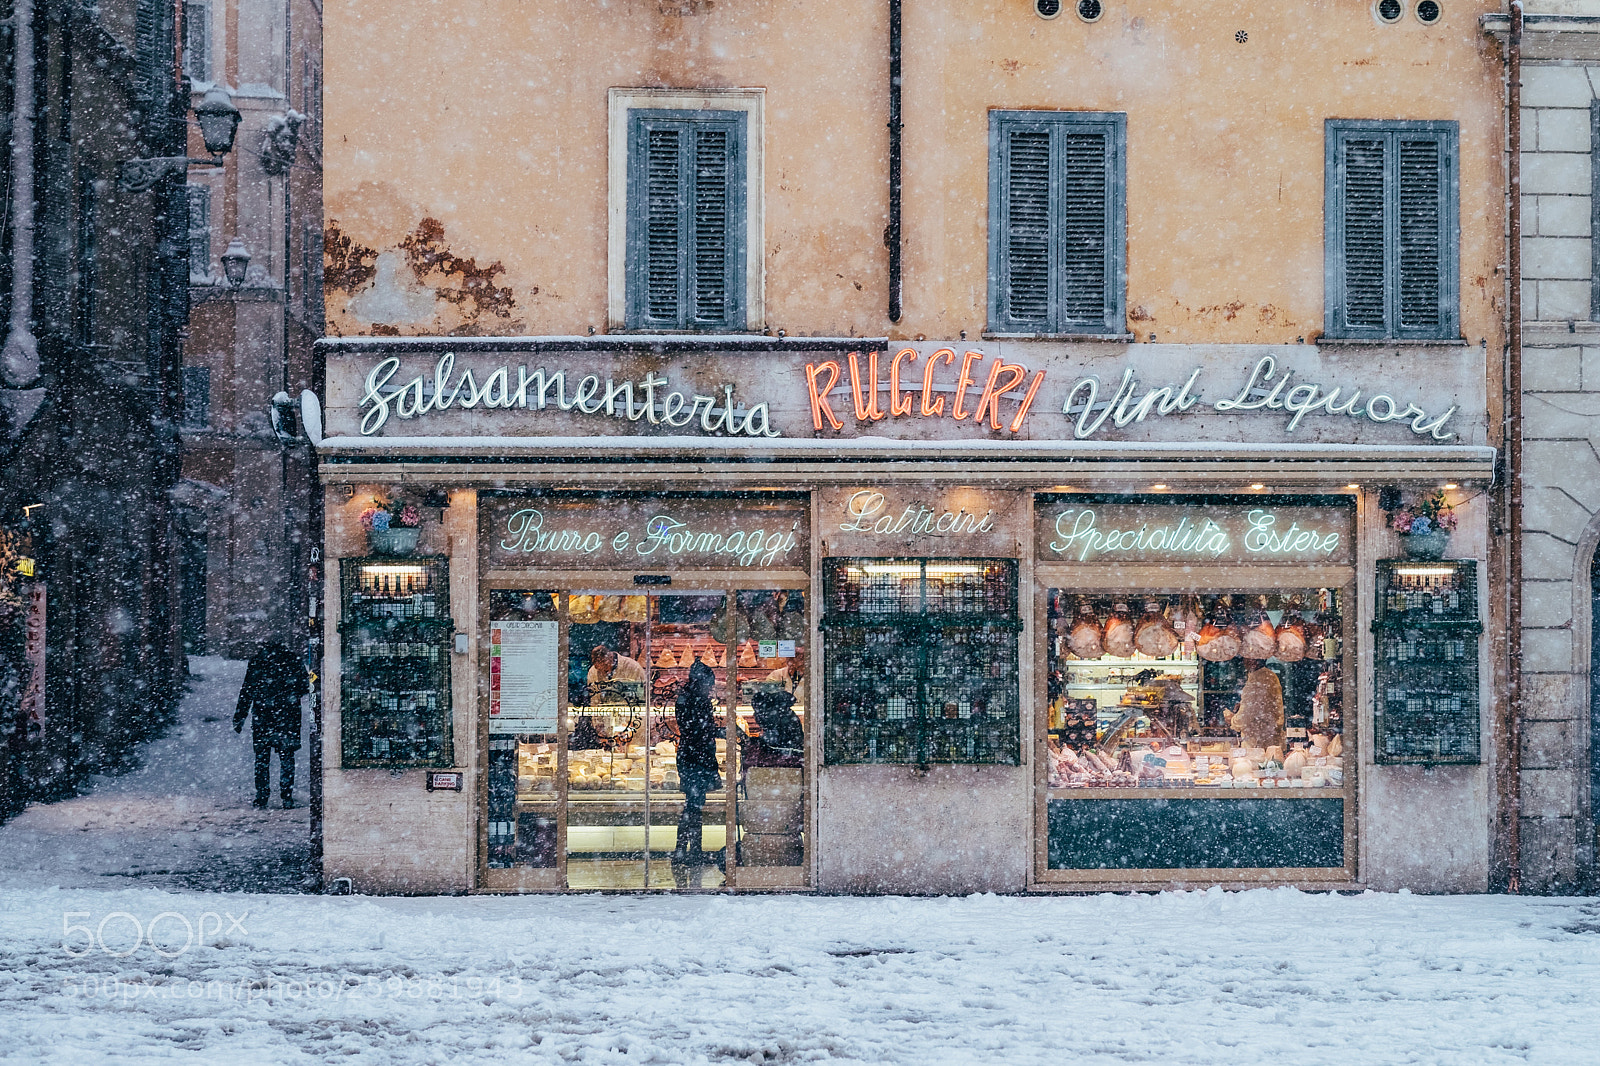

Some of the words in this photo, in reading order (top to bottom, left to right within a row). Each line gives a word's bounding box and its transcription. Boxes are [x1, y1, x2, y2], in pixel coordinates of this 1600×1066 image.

[359, 352, 782, 438] Salsamenteria
[805, 347, 1048, 433] RUGGERI
[1063, 364, 1202, 440] Vini
[1213, 353, 1462, 440] Liquori
[500, 508, 602, 552] Burro
[612, 531, 630, 552] e
[635, 515, 798, 567] Formaggi
[839, 490, 994, 534] Latticini
[1244, 509, 1341, 556] Estere
